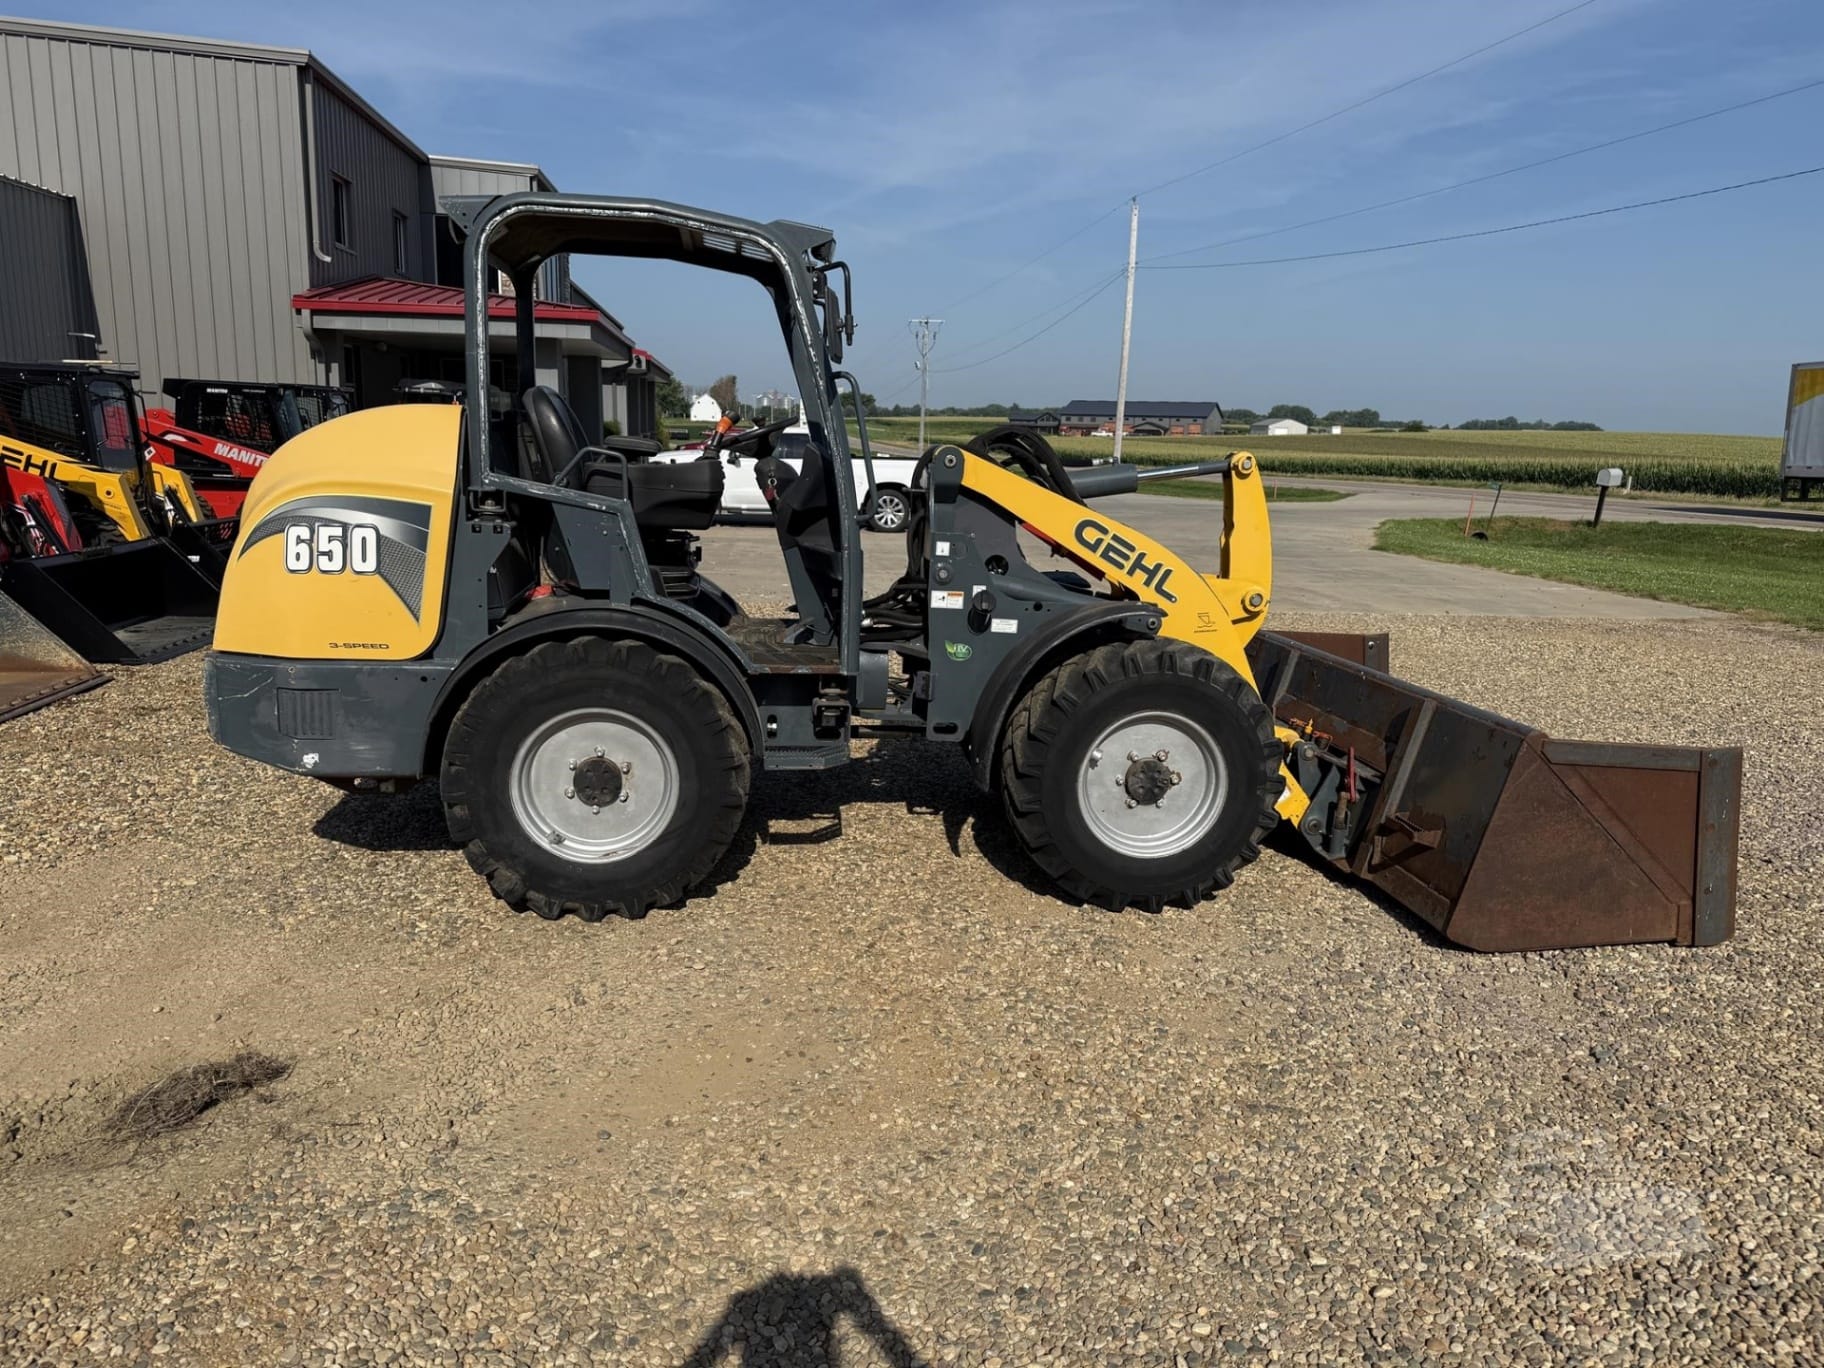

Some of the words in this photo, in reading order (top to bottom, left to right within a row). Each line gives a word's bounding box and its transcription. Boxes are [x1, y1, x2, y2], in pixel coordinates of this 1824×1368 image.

[285, 523, 379, 575] 650
[1074, 519, 1178, 604] GEHL
[328, 642, 390, 650] 3-SPEED
